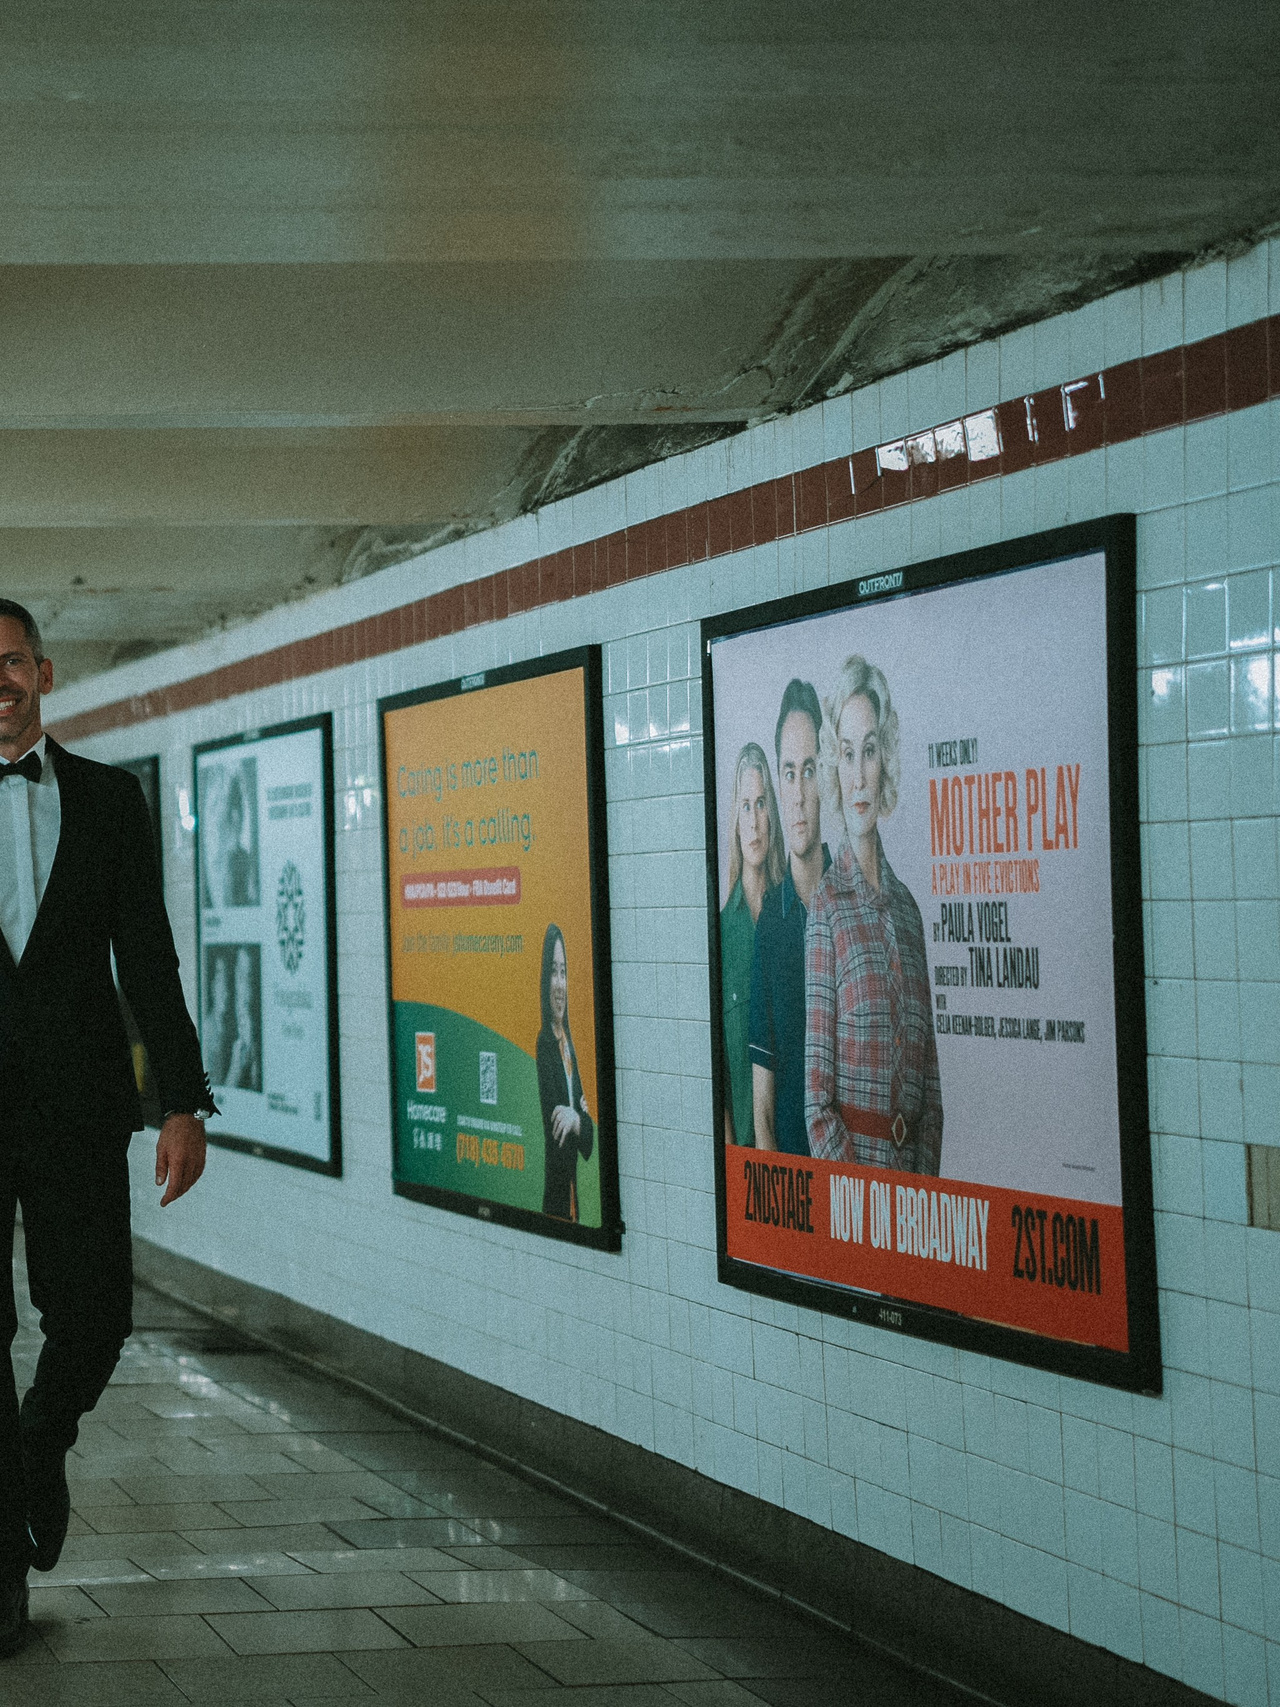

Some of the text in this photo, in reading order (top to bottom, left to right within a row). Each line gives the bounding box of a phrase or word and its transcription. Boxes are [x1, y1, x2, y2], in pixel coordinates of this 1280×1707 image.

[397, 747, 540, 803] Caring is more than
[935, 740, 958, 768] WEEKS
[399, 827, 409, 854] a
[464, 820, 474, 848] a
[479, 807, 537, 853] calling.
[929, 763, 1081, 857] MOTHER PLAY
[932, 859, 1041, 895] A PLAY IN FIVE EVICTIONS
[933, 901, 1012, 943] BY PAULA VOGEL
[934, 947, 1040, 989] DIRECTED BY TINA LANDAU
[936, 1014, 951, 1034] CELIA
[998, 1016, 1021, 1039] JESSICA
[1044, 1019, 1056, 1042] JIM
[1057, 1020, 1085, 1043] PARSONS
[743, 1160, 815, 1234] 2NDSTAGE
[829, 1174, 990, 1271] NOW ON BROADWAY
[1011, 1205, 1102, 1296] 2ST.COM
